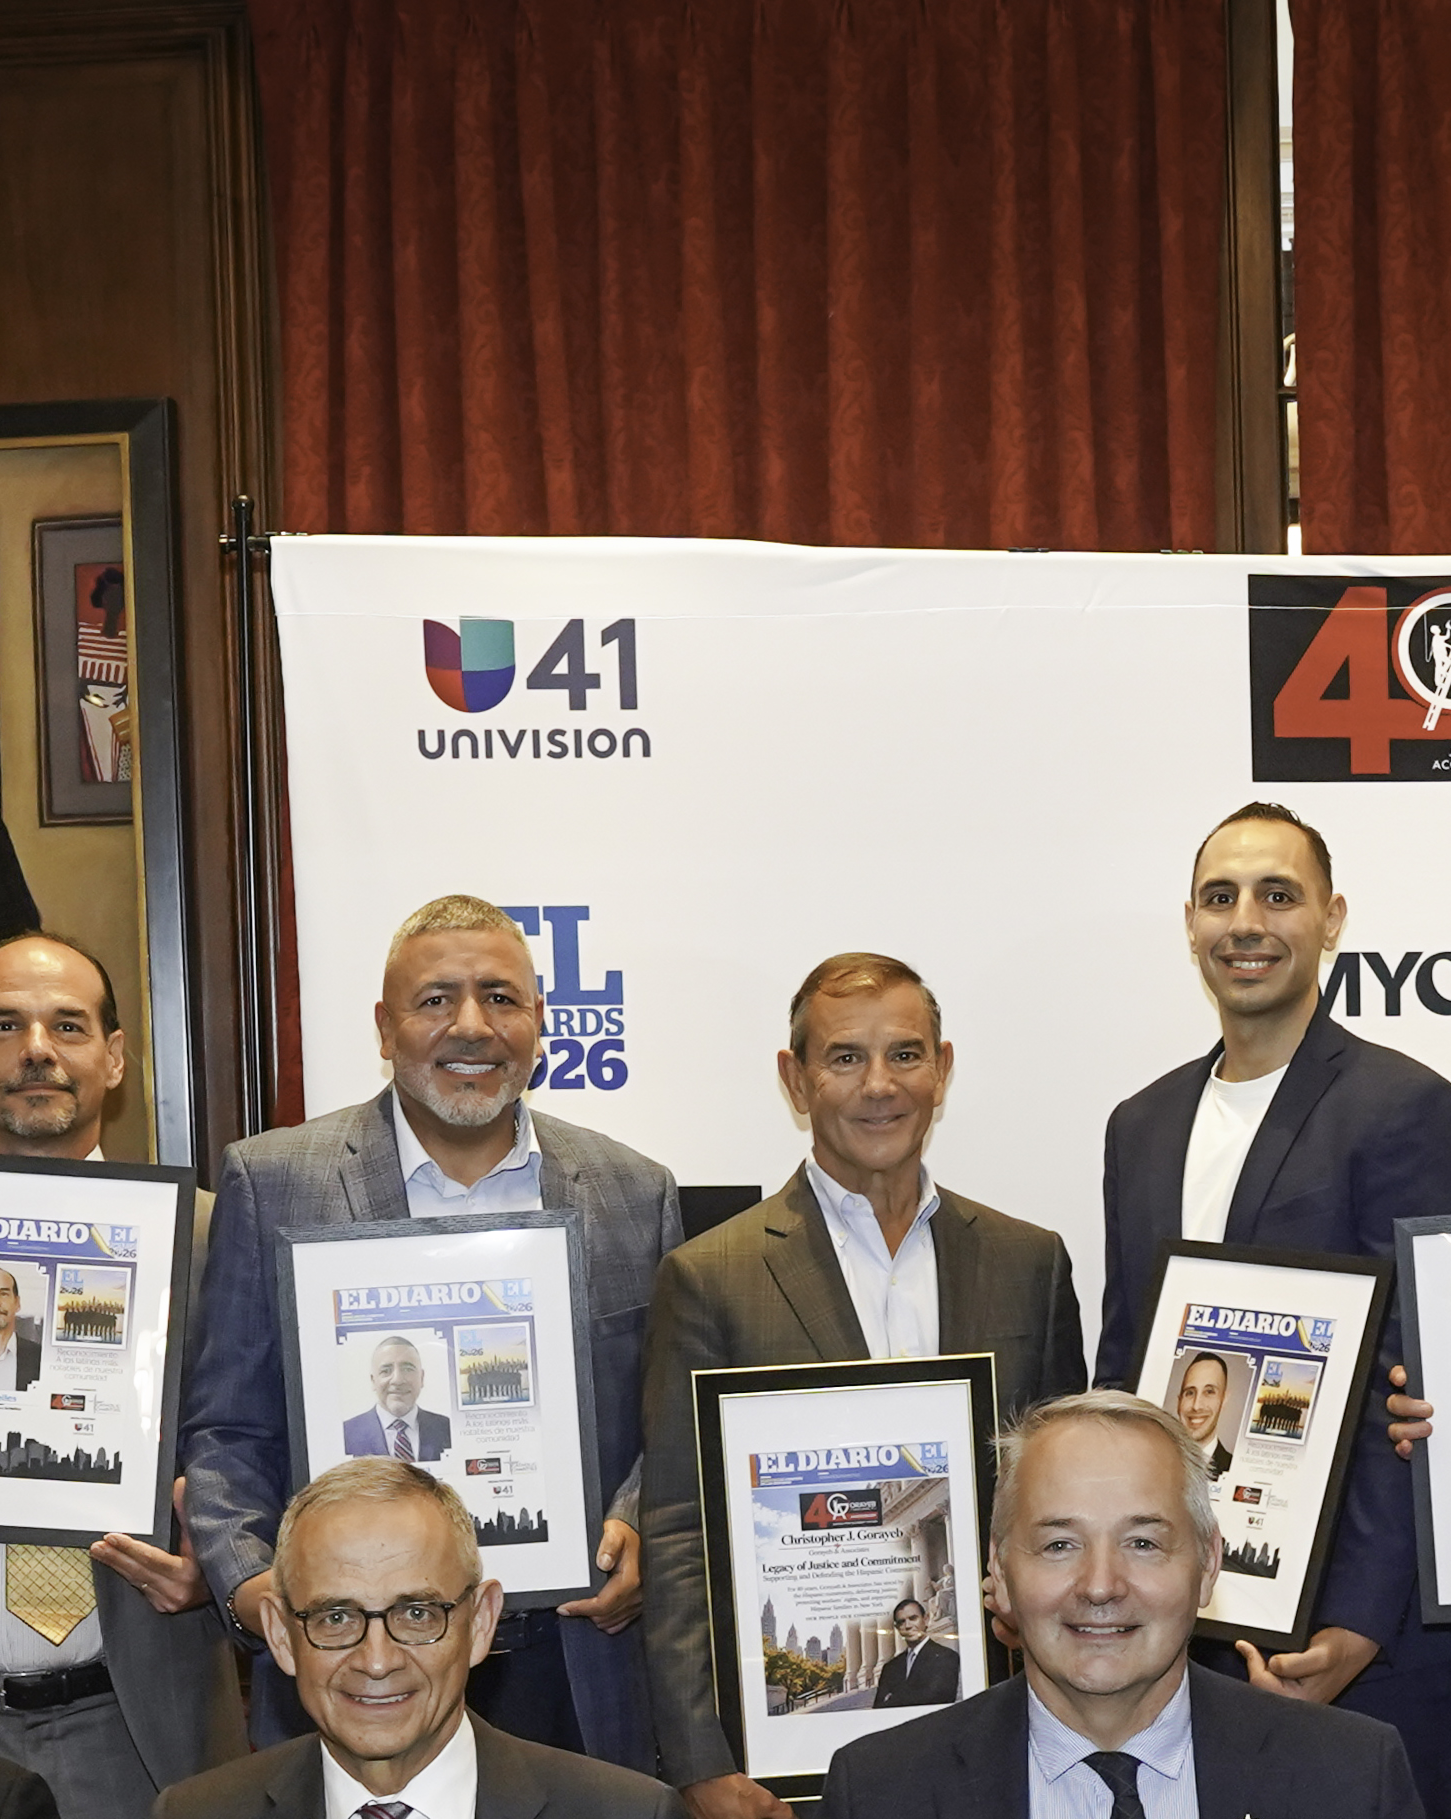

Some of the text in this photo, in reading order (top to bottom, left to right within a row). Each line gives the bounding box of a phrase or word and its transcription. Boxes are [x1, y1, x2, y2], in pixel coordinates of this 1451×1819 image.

[527, 618, 638, 711] 41
[340, 1282, 482, 1310] EL DIARIO
[1187, 1305, 1297, 1337] EL DIARIO
[757, 1445, 899, 1474] EL DIARIO
[781, 1527, 903, 1548] Christopher J. Gorayeb
[762, 1553, 920, 1575] Legacy of Justice and Commitment
[811, 1570, 843, 1580] Defending
